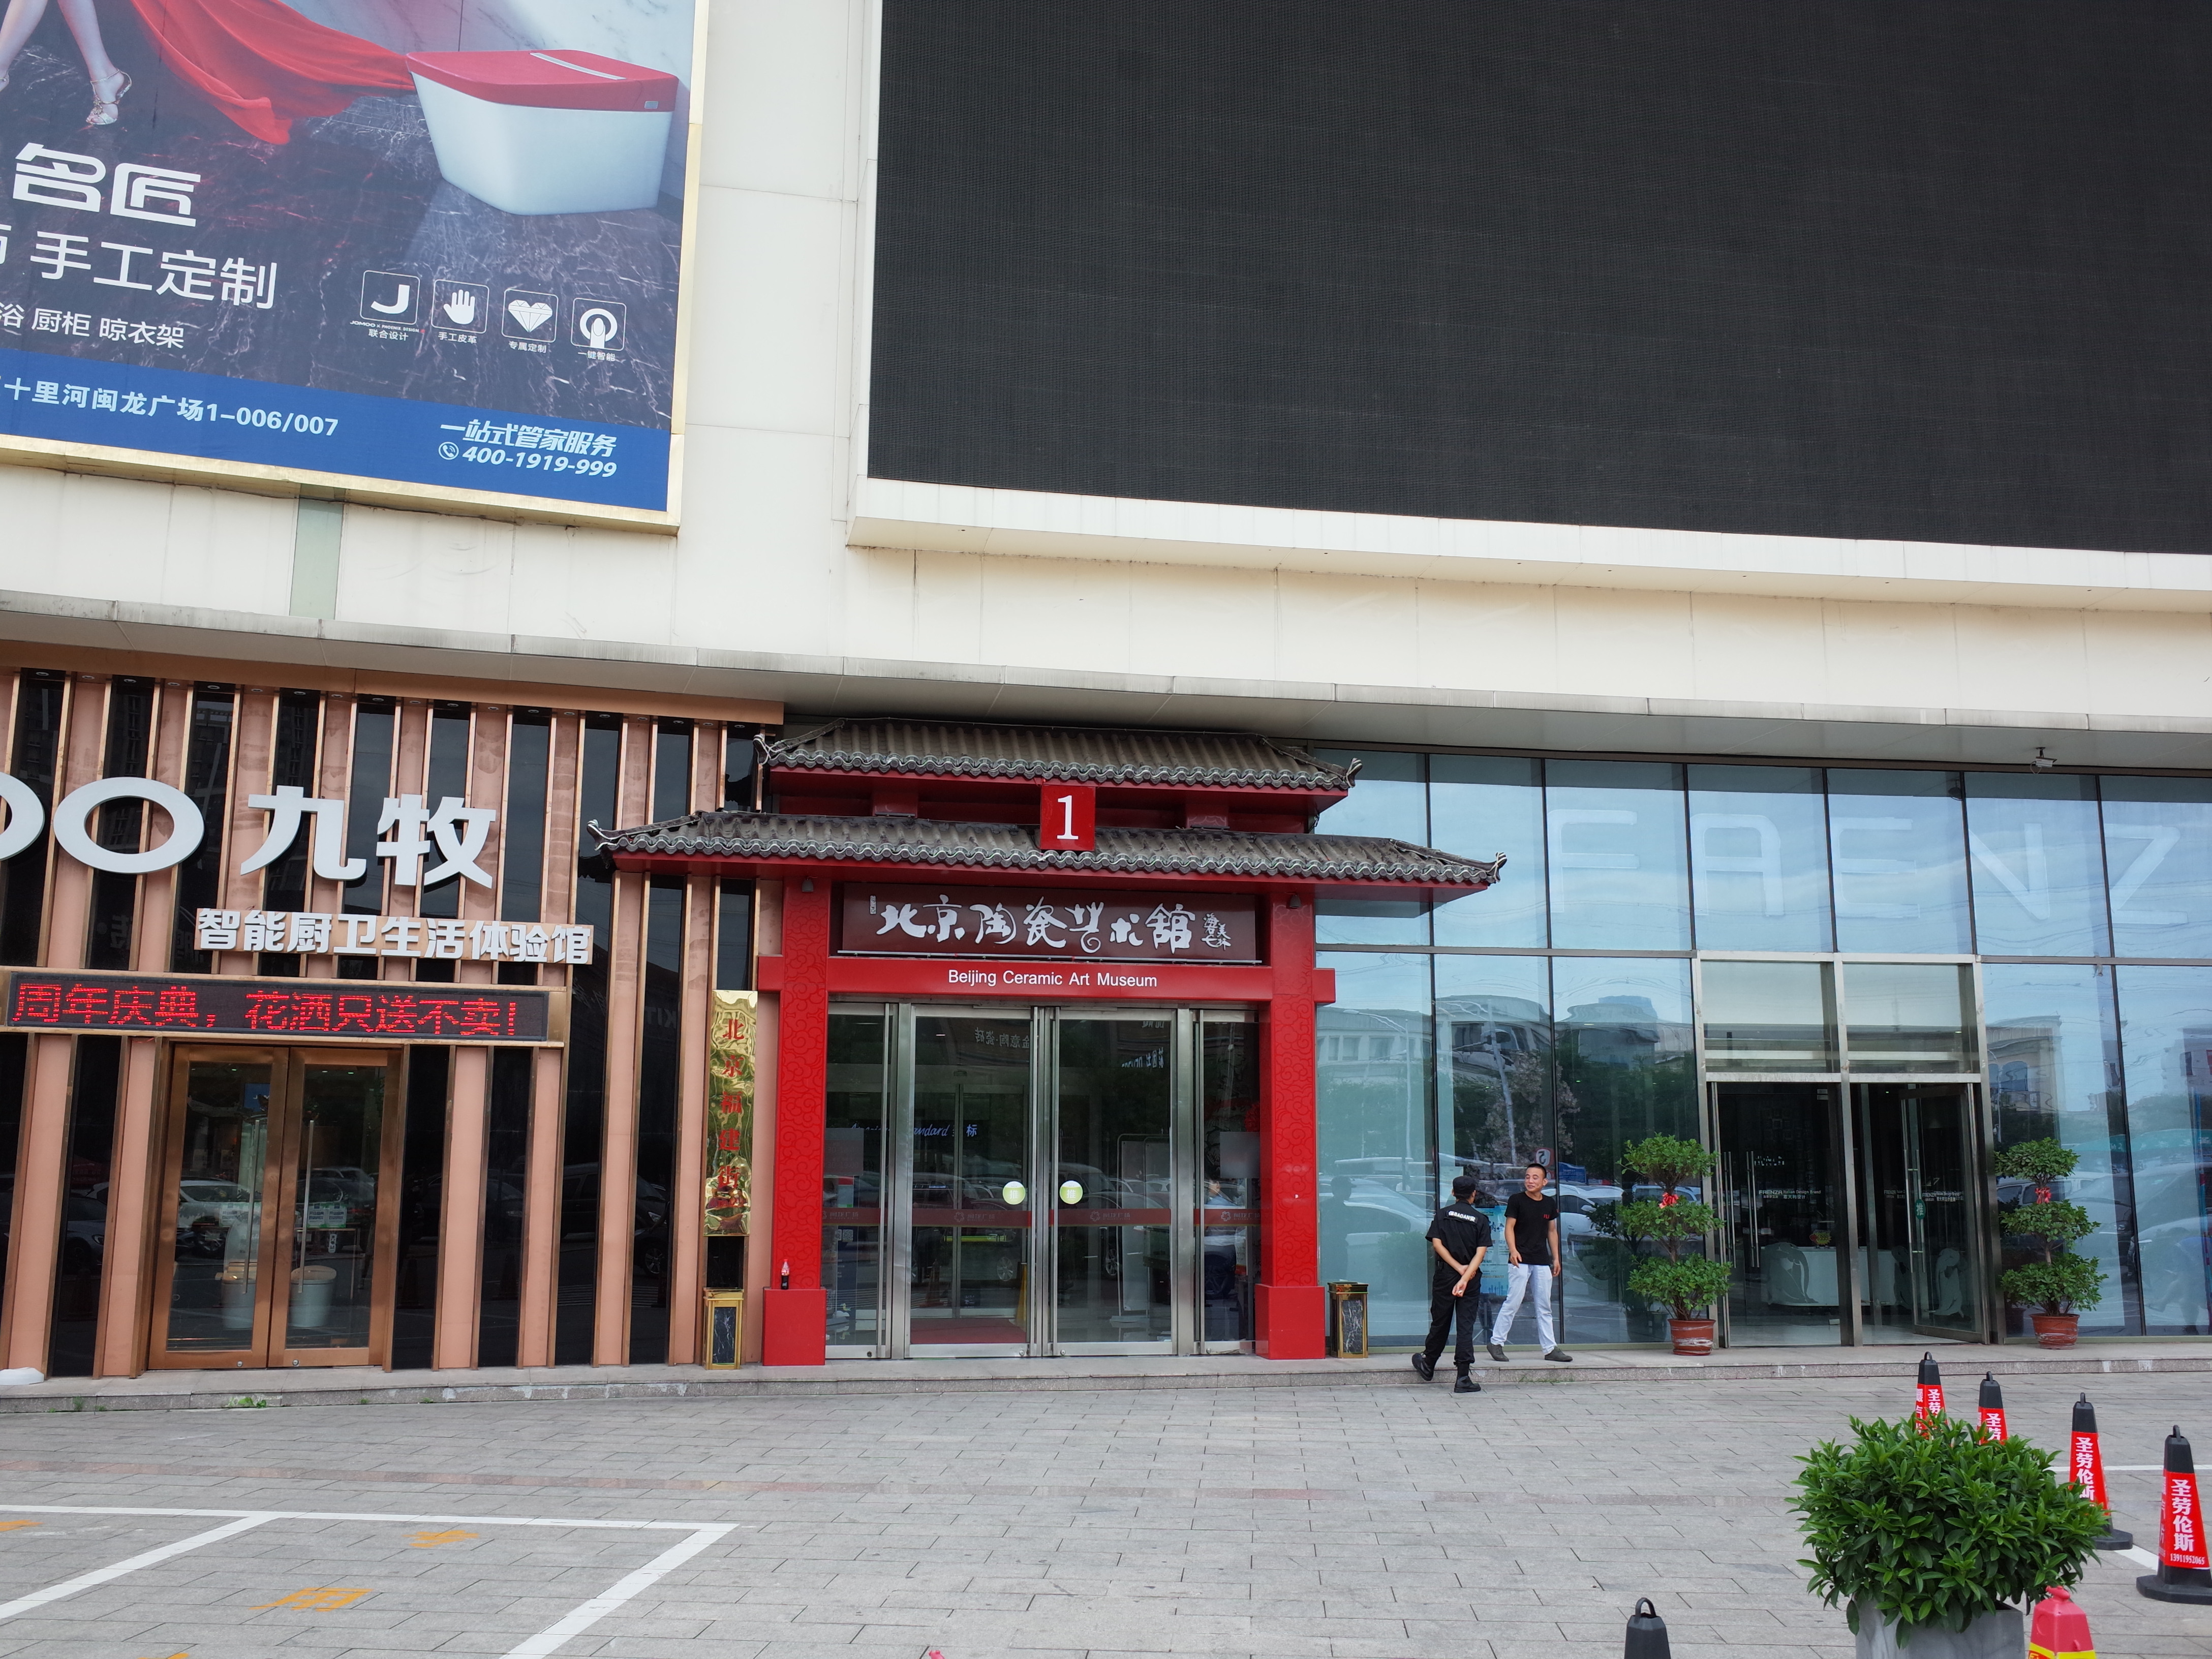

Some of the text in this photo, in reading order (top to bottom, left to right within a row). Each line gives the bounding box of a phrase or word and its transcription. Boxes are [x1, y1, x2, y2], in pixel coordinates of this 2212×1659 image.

[13, 142, 201, 227] 名匠
[30, 231, 278, 309] 手工定制
[32, 309, 91, 337] 厨柜
[99, 318, 185, 349] 晾衣架
[368, 329, 409, 341] 联合设计
[438, 332, 477, 344] 手工皮革
[508, 341, 547, 353] 专属定制
[578, 351, 616, 362] 一键智能
[4, 378, 339, 437] 十里河闽龙广场1-006/007
[440, 420, 618, 457] 一站式管家服务
[463, 442, 617, 478] 400-1919-999
[1057, 795, 1079, 840] 1
[240, 785, 497, 889] 九牧
[197, 908, 591, 964] 智能厨卫生活体验馆
[948, 970, 1157, 988] Beijing Ceramic Art Museum
[718, 1019, 745, 1188] 北京福建街
[914, 1123, 948, 1136] andard
[1009, 1190, 1019, 1200] 推
[1067, 1189, 1076, 1199] 推
[1916, 1203, 1924, 1215] 推
[2171, 1479, 2194, 1552] 圣劳伦斯
[2170, 1553, 2205, 1565] 13911952065
